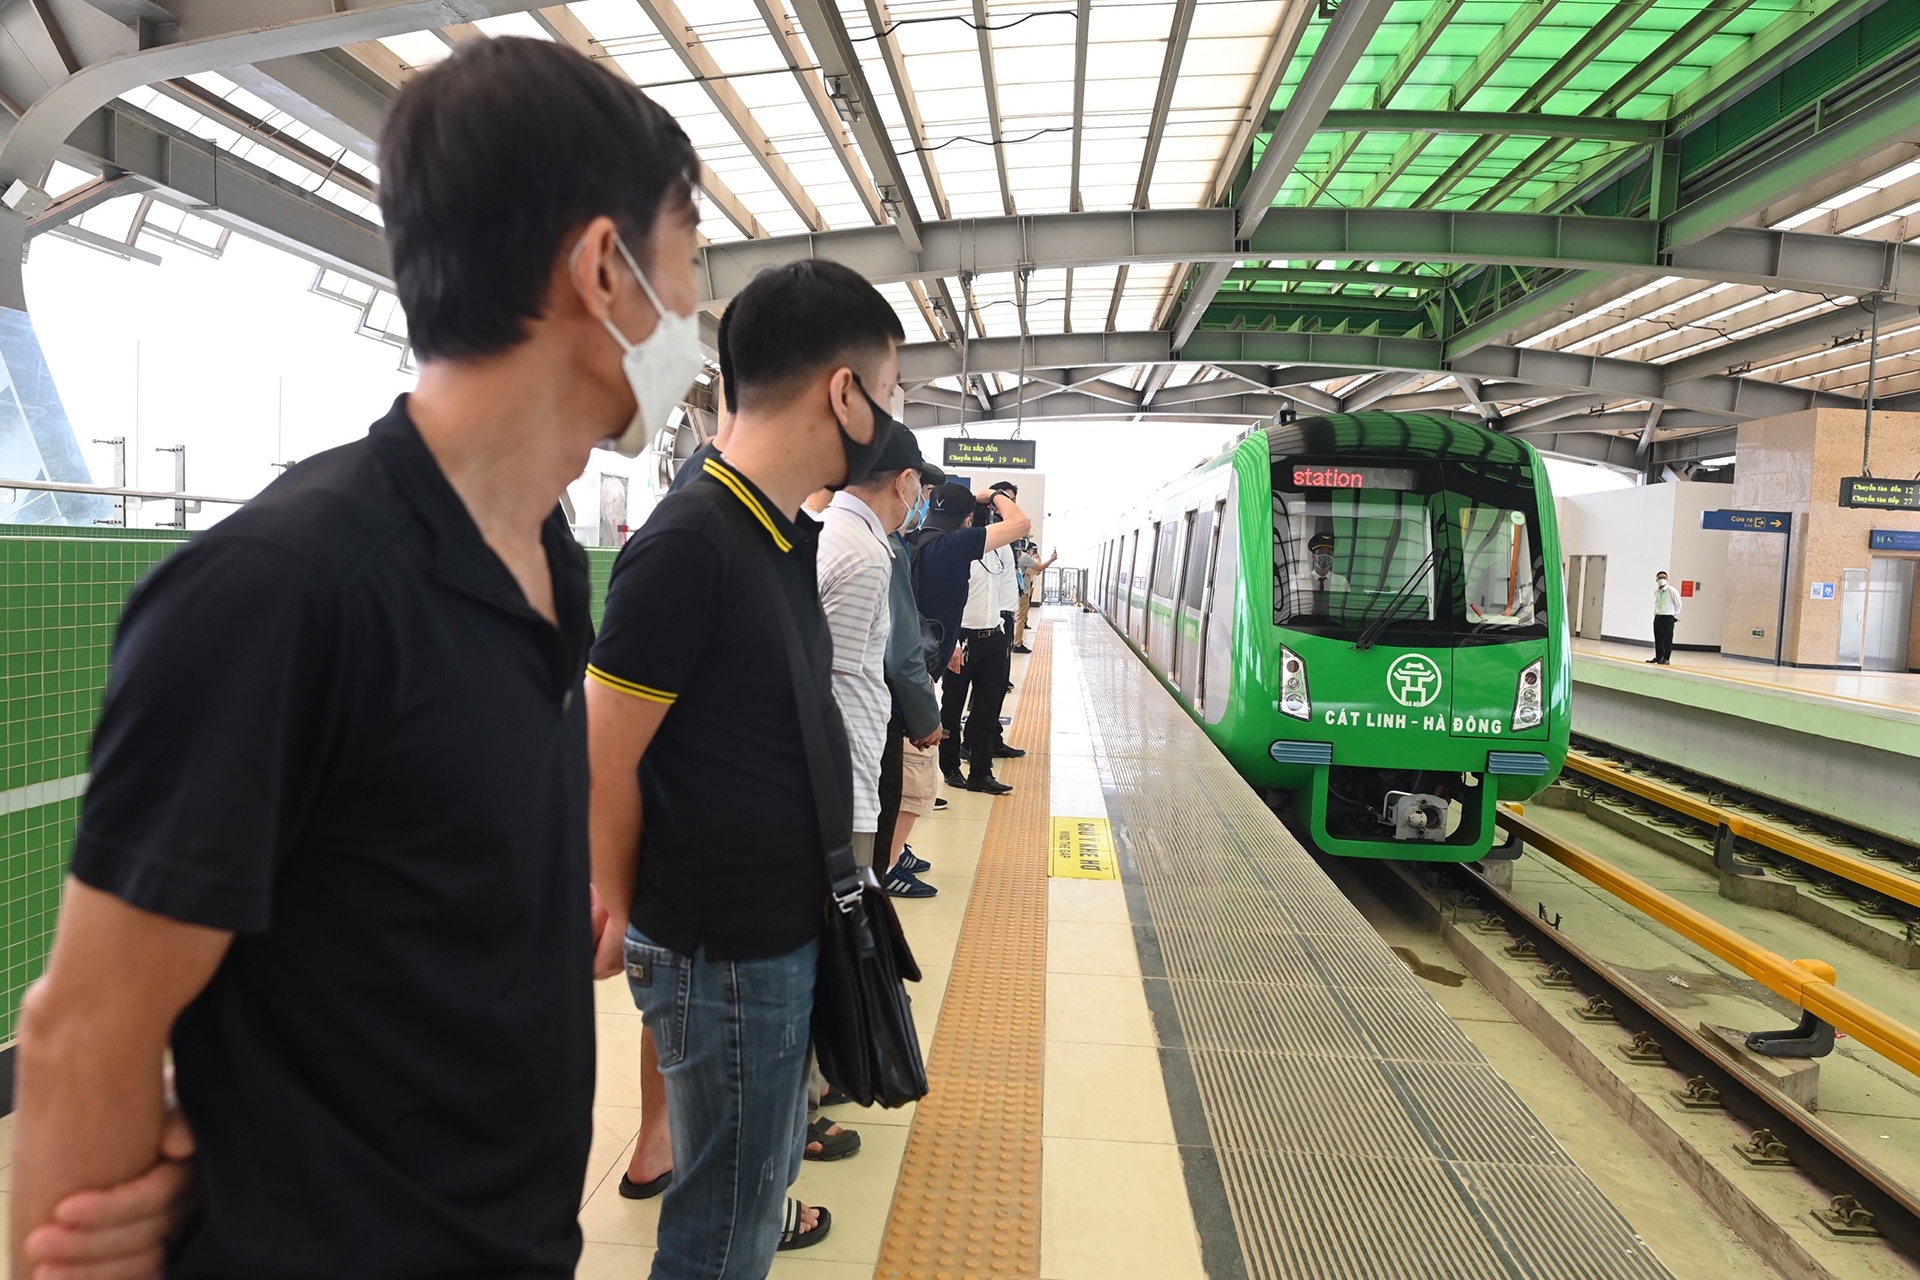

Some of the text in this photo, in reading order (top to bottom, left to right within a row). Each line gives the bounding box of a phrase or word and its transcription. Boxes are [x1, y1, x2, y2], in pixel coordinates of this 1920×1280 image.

[972, 443, 984, 452] sắp
[985, 443, 998, 452] đến
[1293, 467, 1363, 488] station
[1324, 707, 1360, 726] CÁT
[1366, 712, 1406, 729] LINH
[1423, 713, 1446, 731] HÀ
[1453, 715, 1502, 734] ĐÔNG
[1079, 843, 1099, 857] KHE
